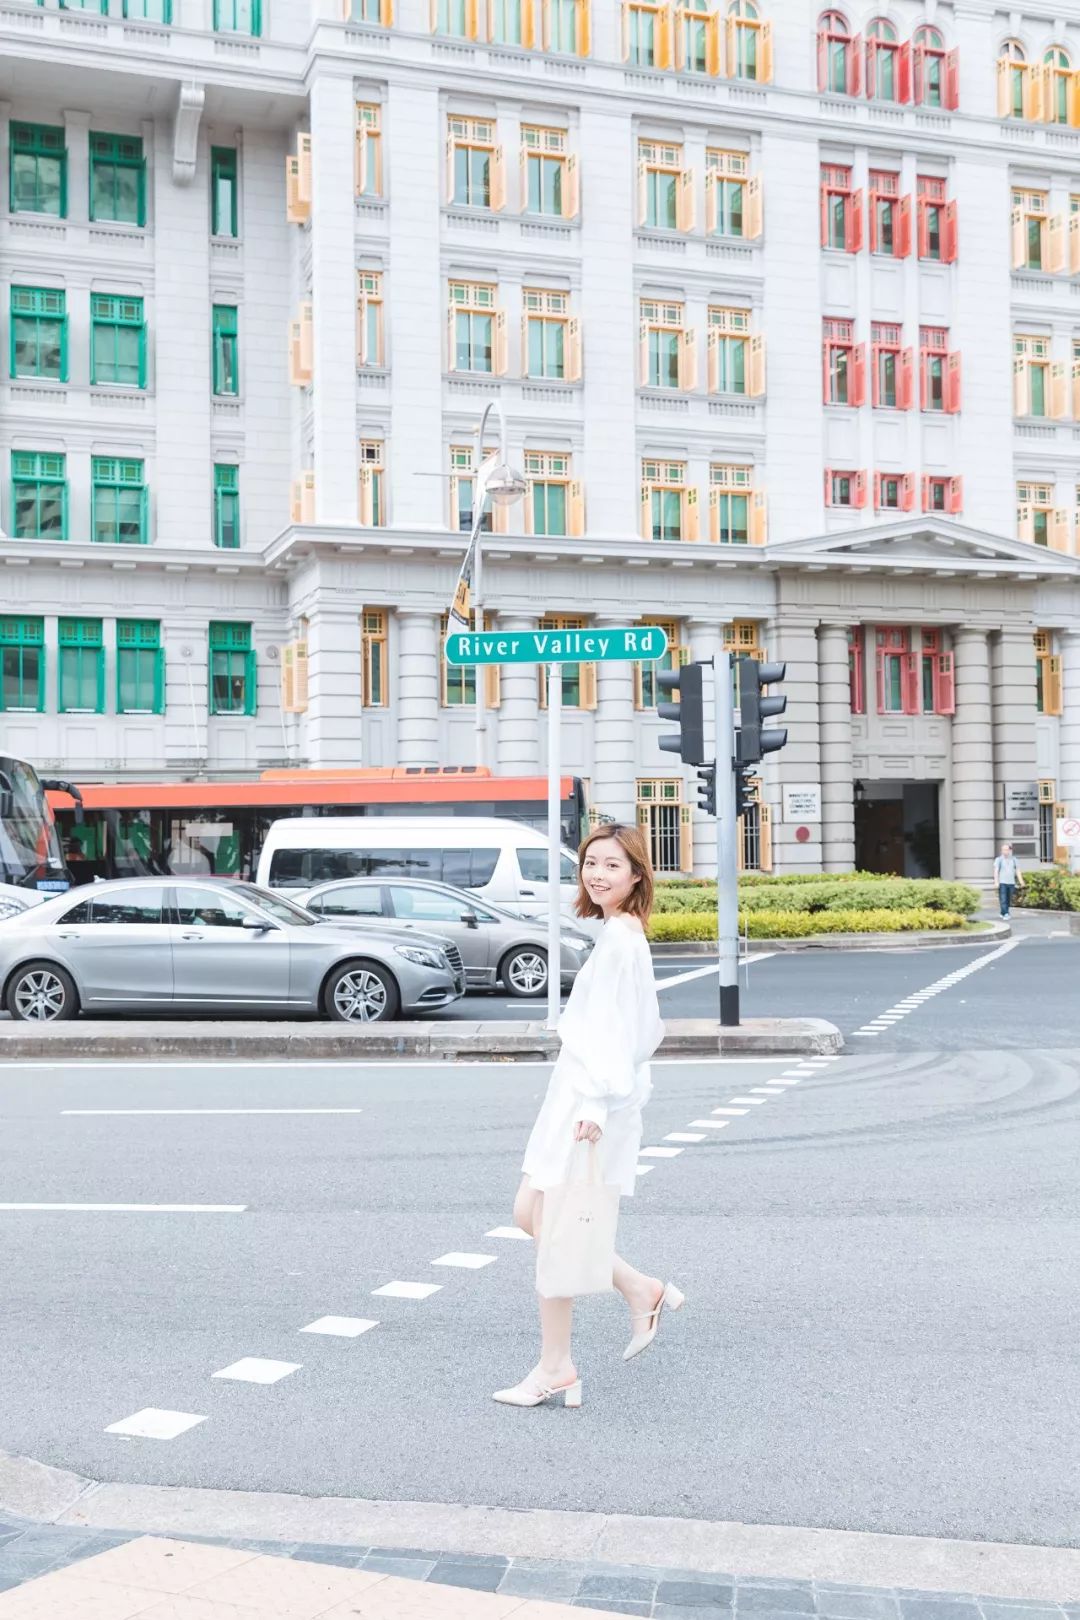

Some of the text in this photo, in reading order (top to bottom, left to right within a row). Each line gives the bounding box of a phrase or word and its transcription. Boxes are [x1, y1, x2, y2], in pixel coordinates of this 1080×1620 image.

[458, 631, 653, 657] River Valley Rd
